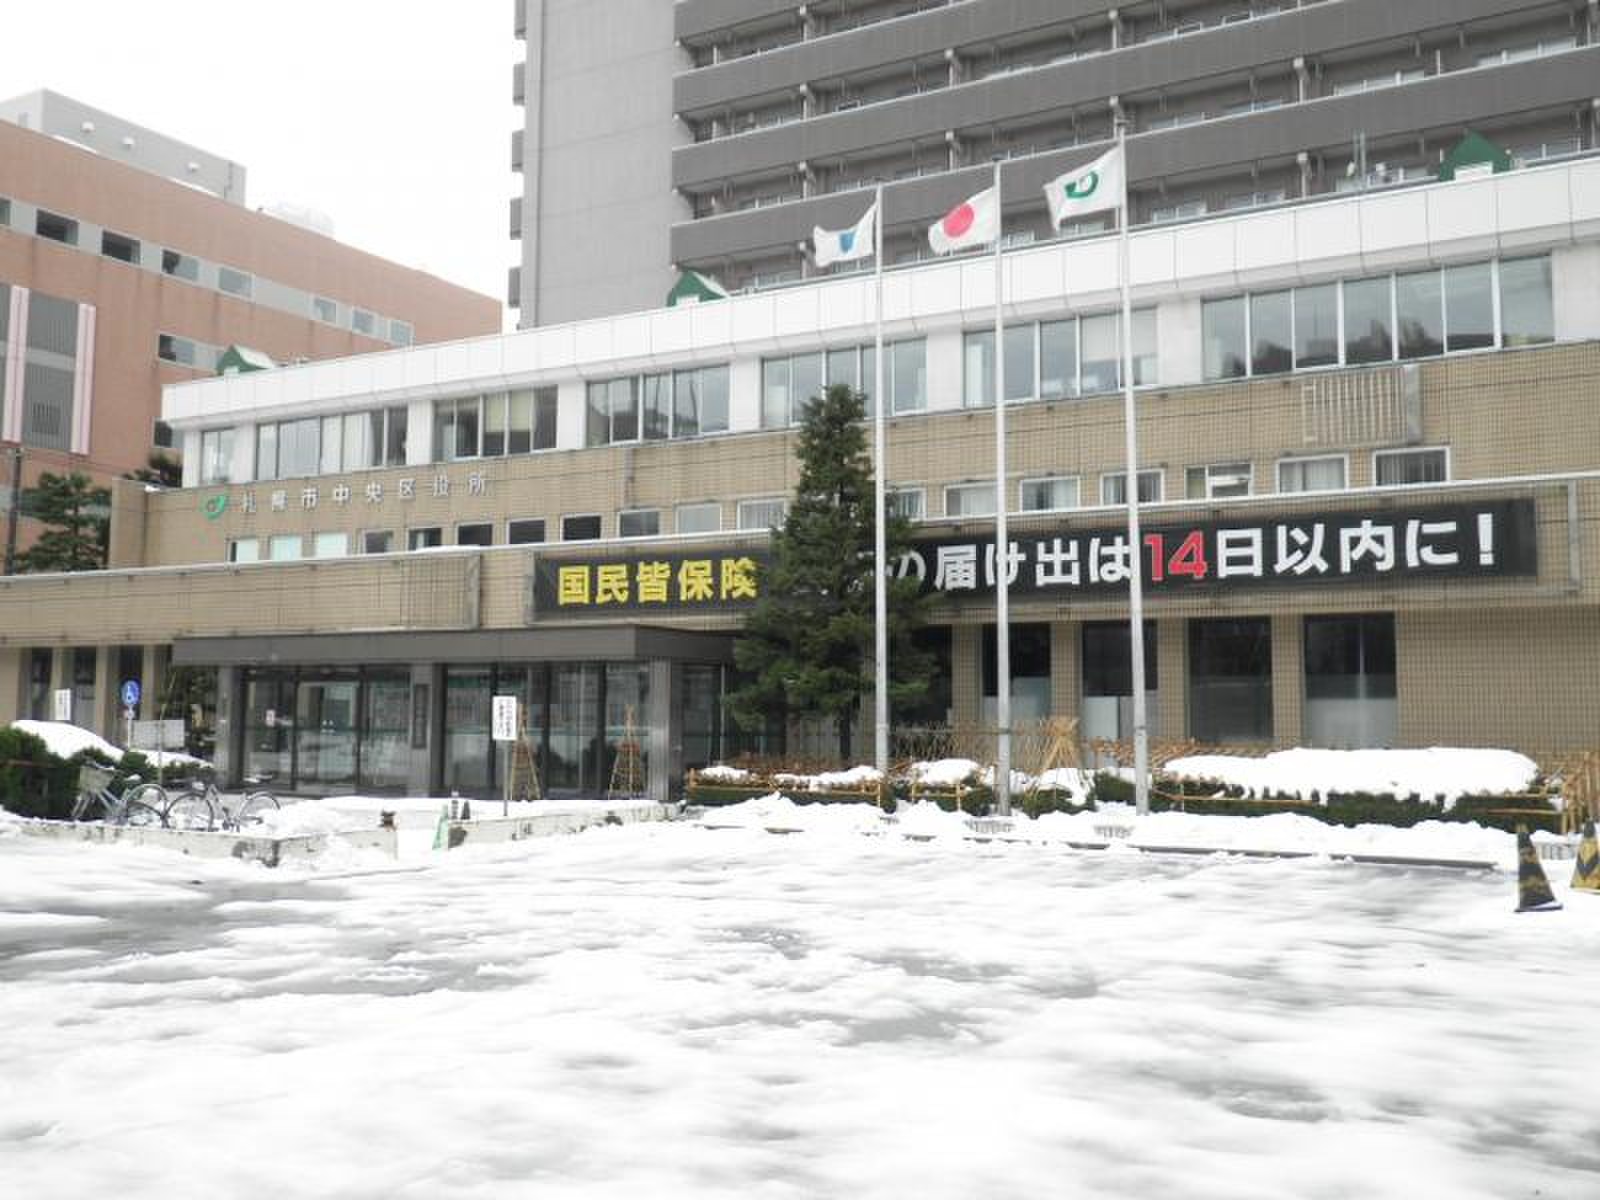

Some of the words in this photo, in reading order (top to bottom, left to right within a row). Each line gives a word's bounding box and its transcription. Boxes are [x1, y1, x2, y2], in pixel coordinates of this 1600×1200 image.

[557, 556, 758, 606] 国民皆保険
